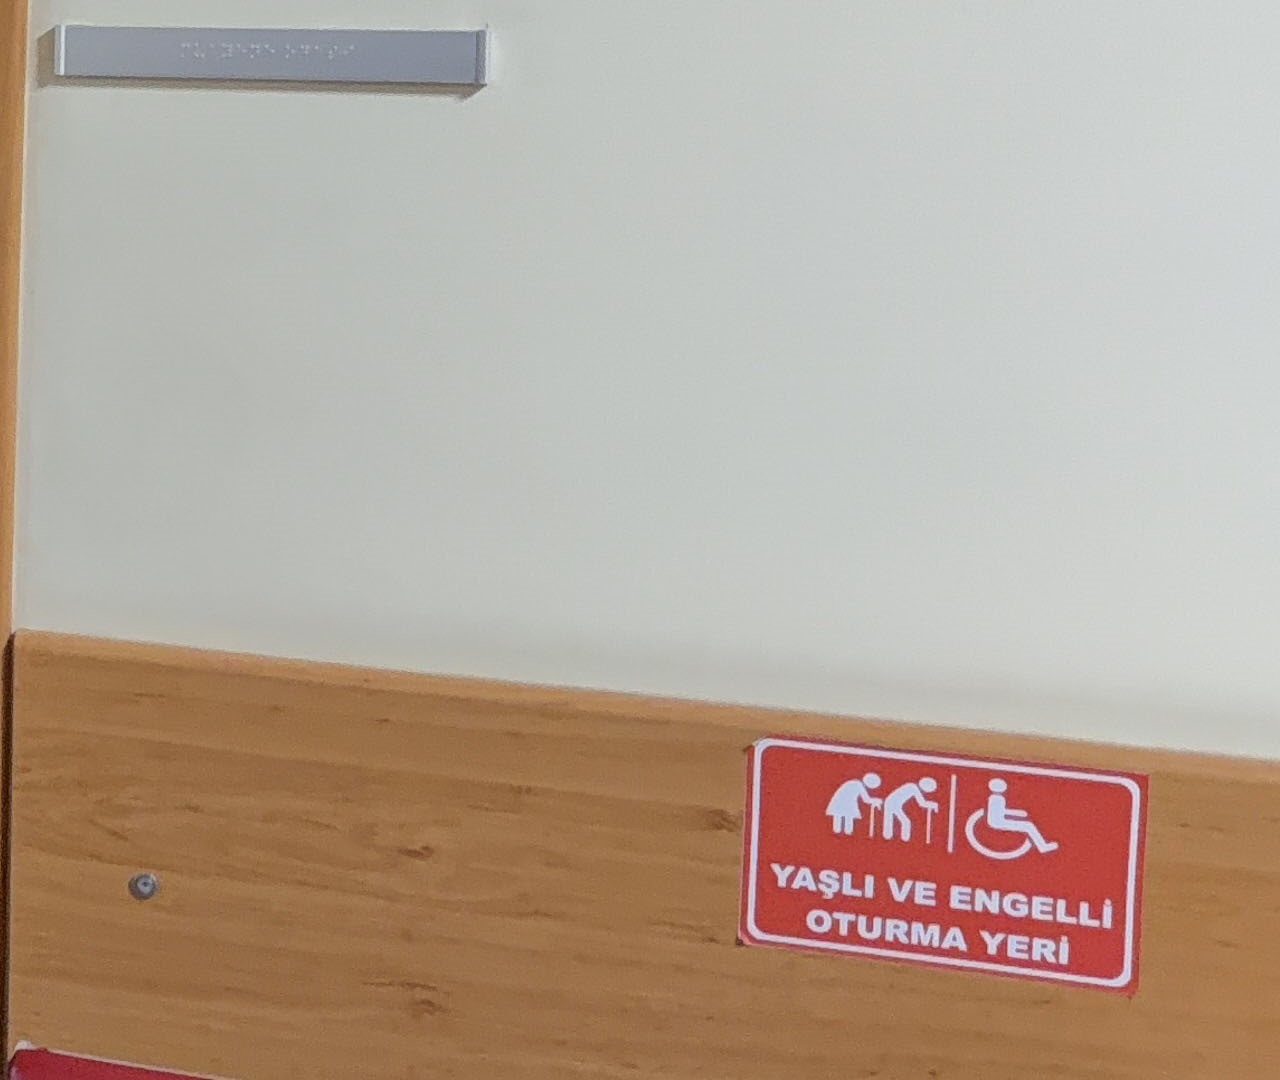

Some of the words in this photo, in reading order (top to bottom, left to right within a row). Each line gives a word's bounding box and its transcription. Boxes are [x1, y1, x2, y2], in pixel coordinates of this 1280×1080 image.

[770, 863, 875, 900] YAŞLI
[887, 877, 937, 907] VE
[949, 885, 1113, 930] ENGELLİ
[806, 909, 968, 952] OTURMA
[979, 930, 1070, 965] YERİ
